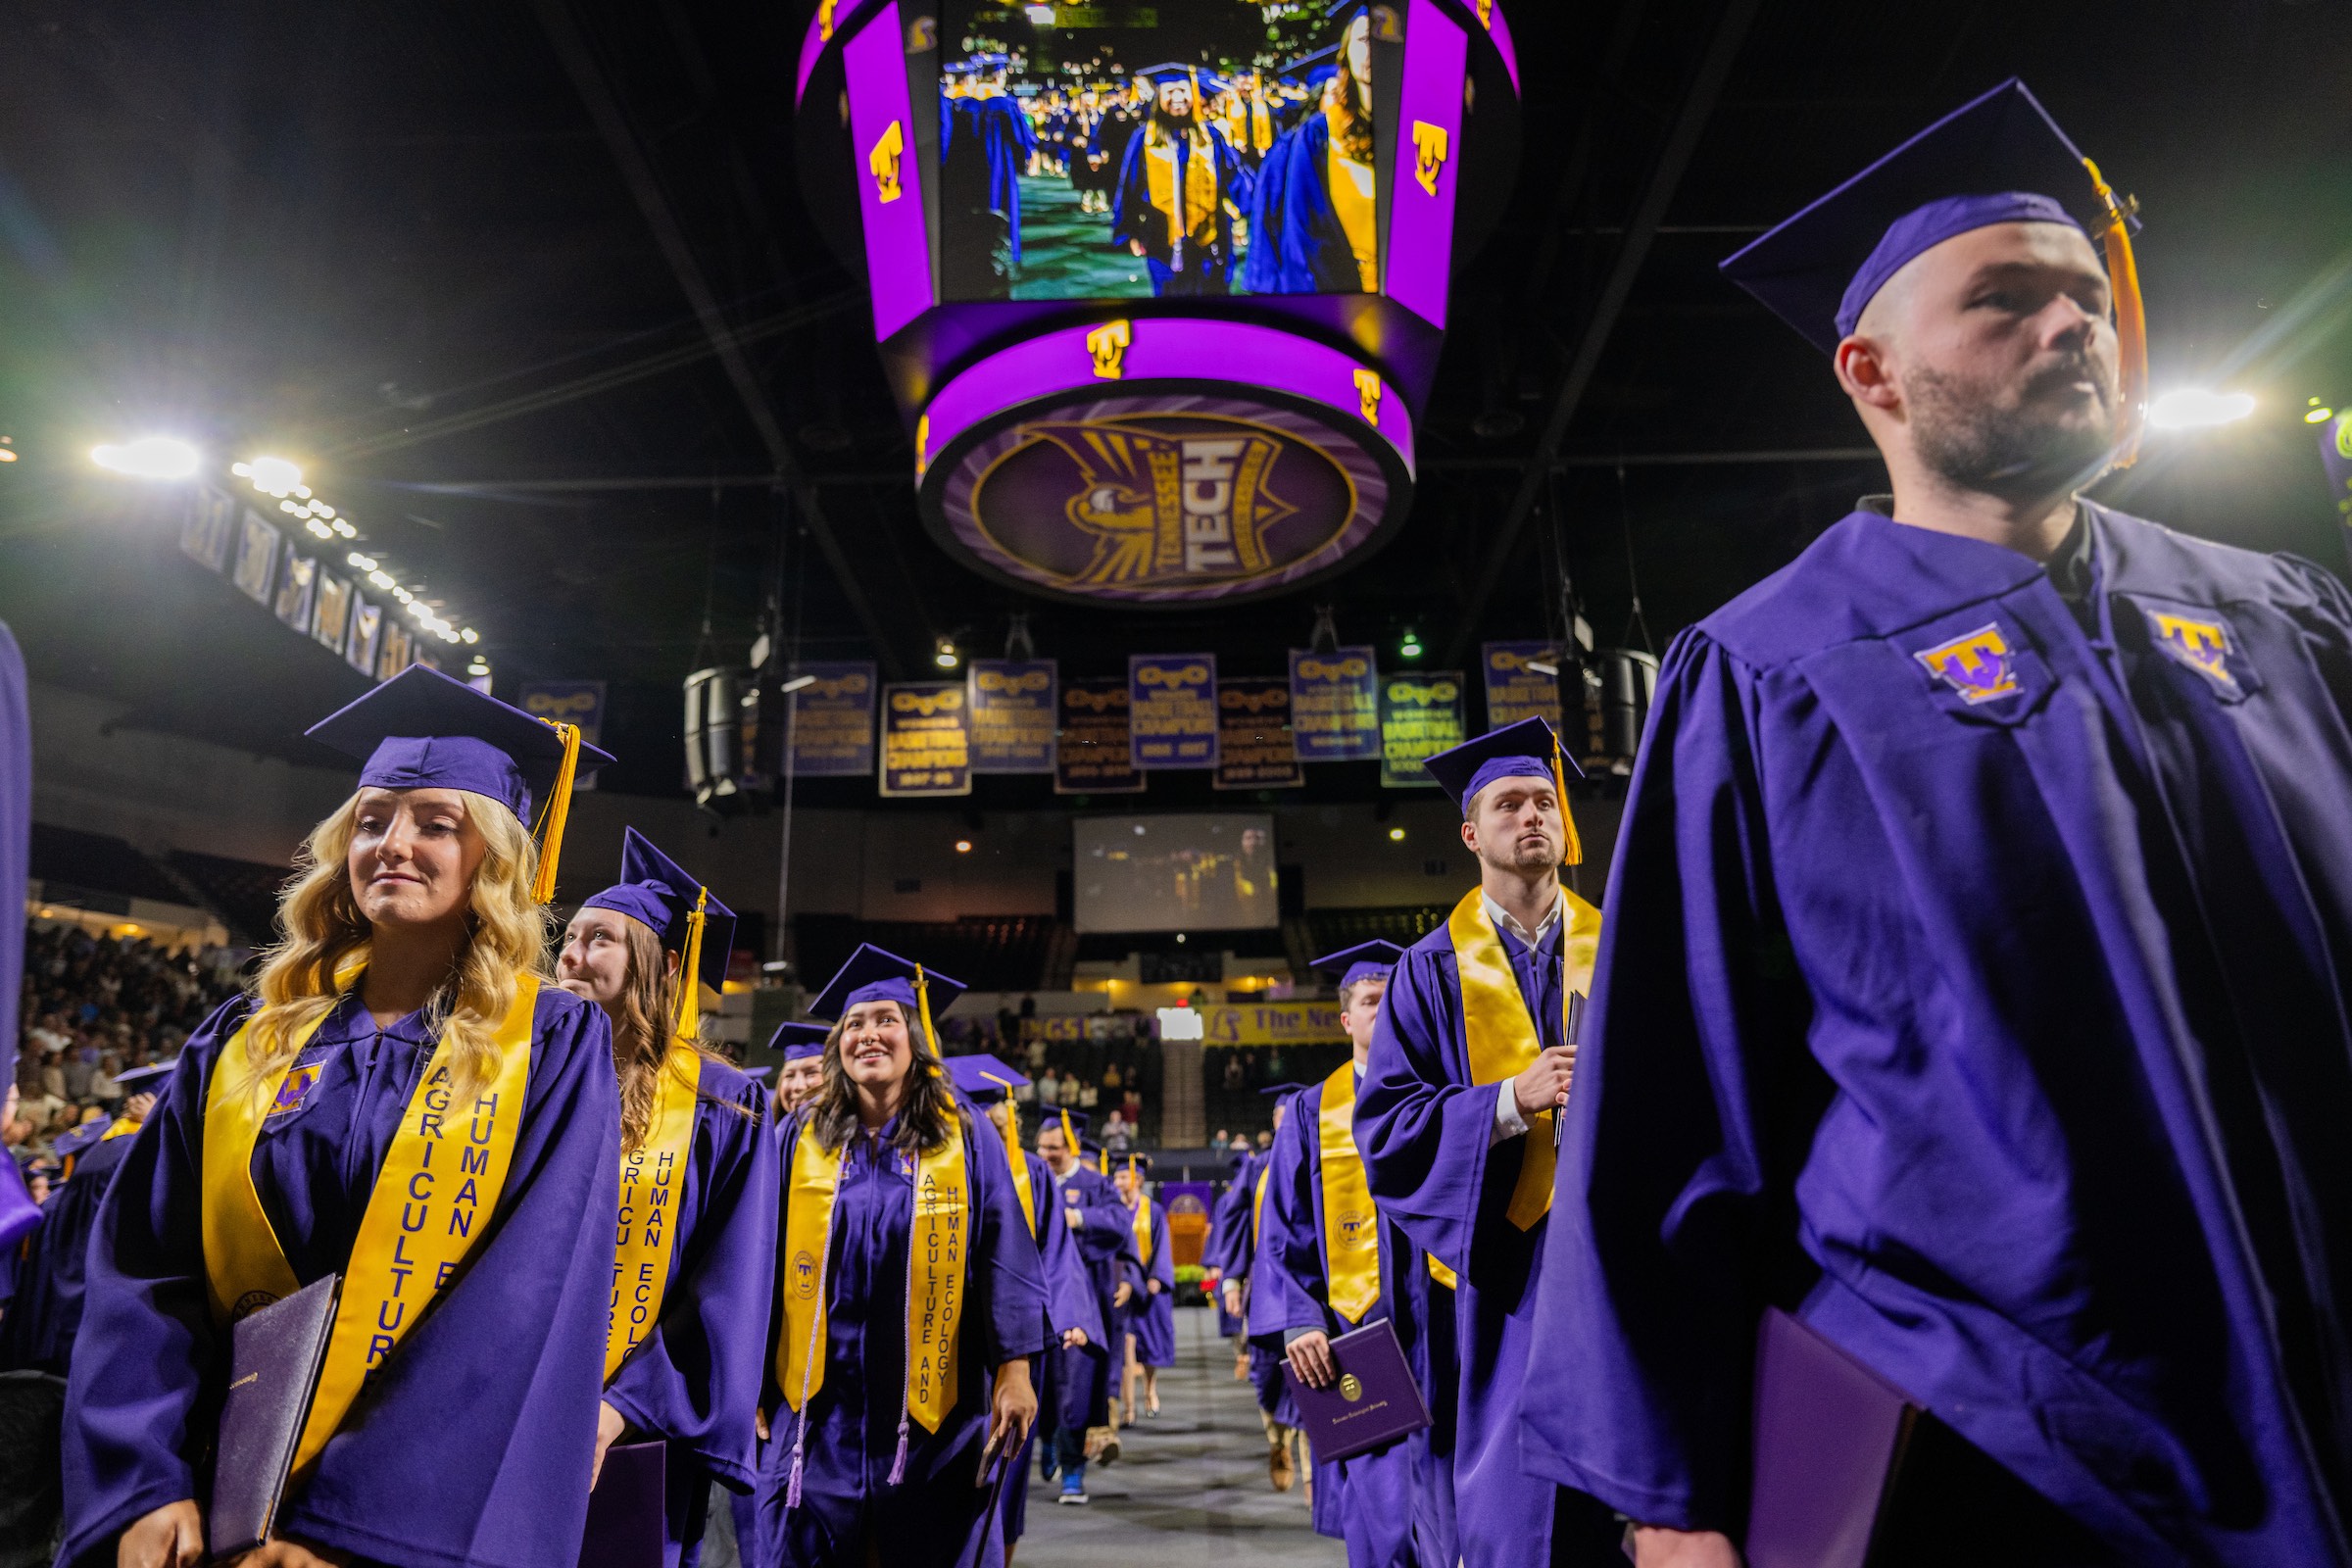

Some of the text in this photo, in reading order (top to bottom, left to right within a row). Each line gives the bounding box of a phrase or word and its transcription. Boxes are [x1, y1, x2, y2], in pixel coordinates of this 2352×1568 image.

[1182, 440, 1247, 572] TECH
[448, 1093, 498, 1238] HUMAN
[644, 1152, 674, 1248] HUMAN
[919, 1174, 939, 1403] AGRICULTURE AND
[937, 1187, 959, 1386] HUMAN ECOLOGY
